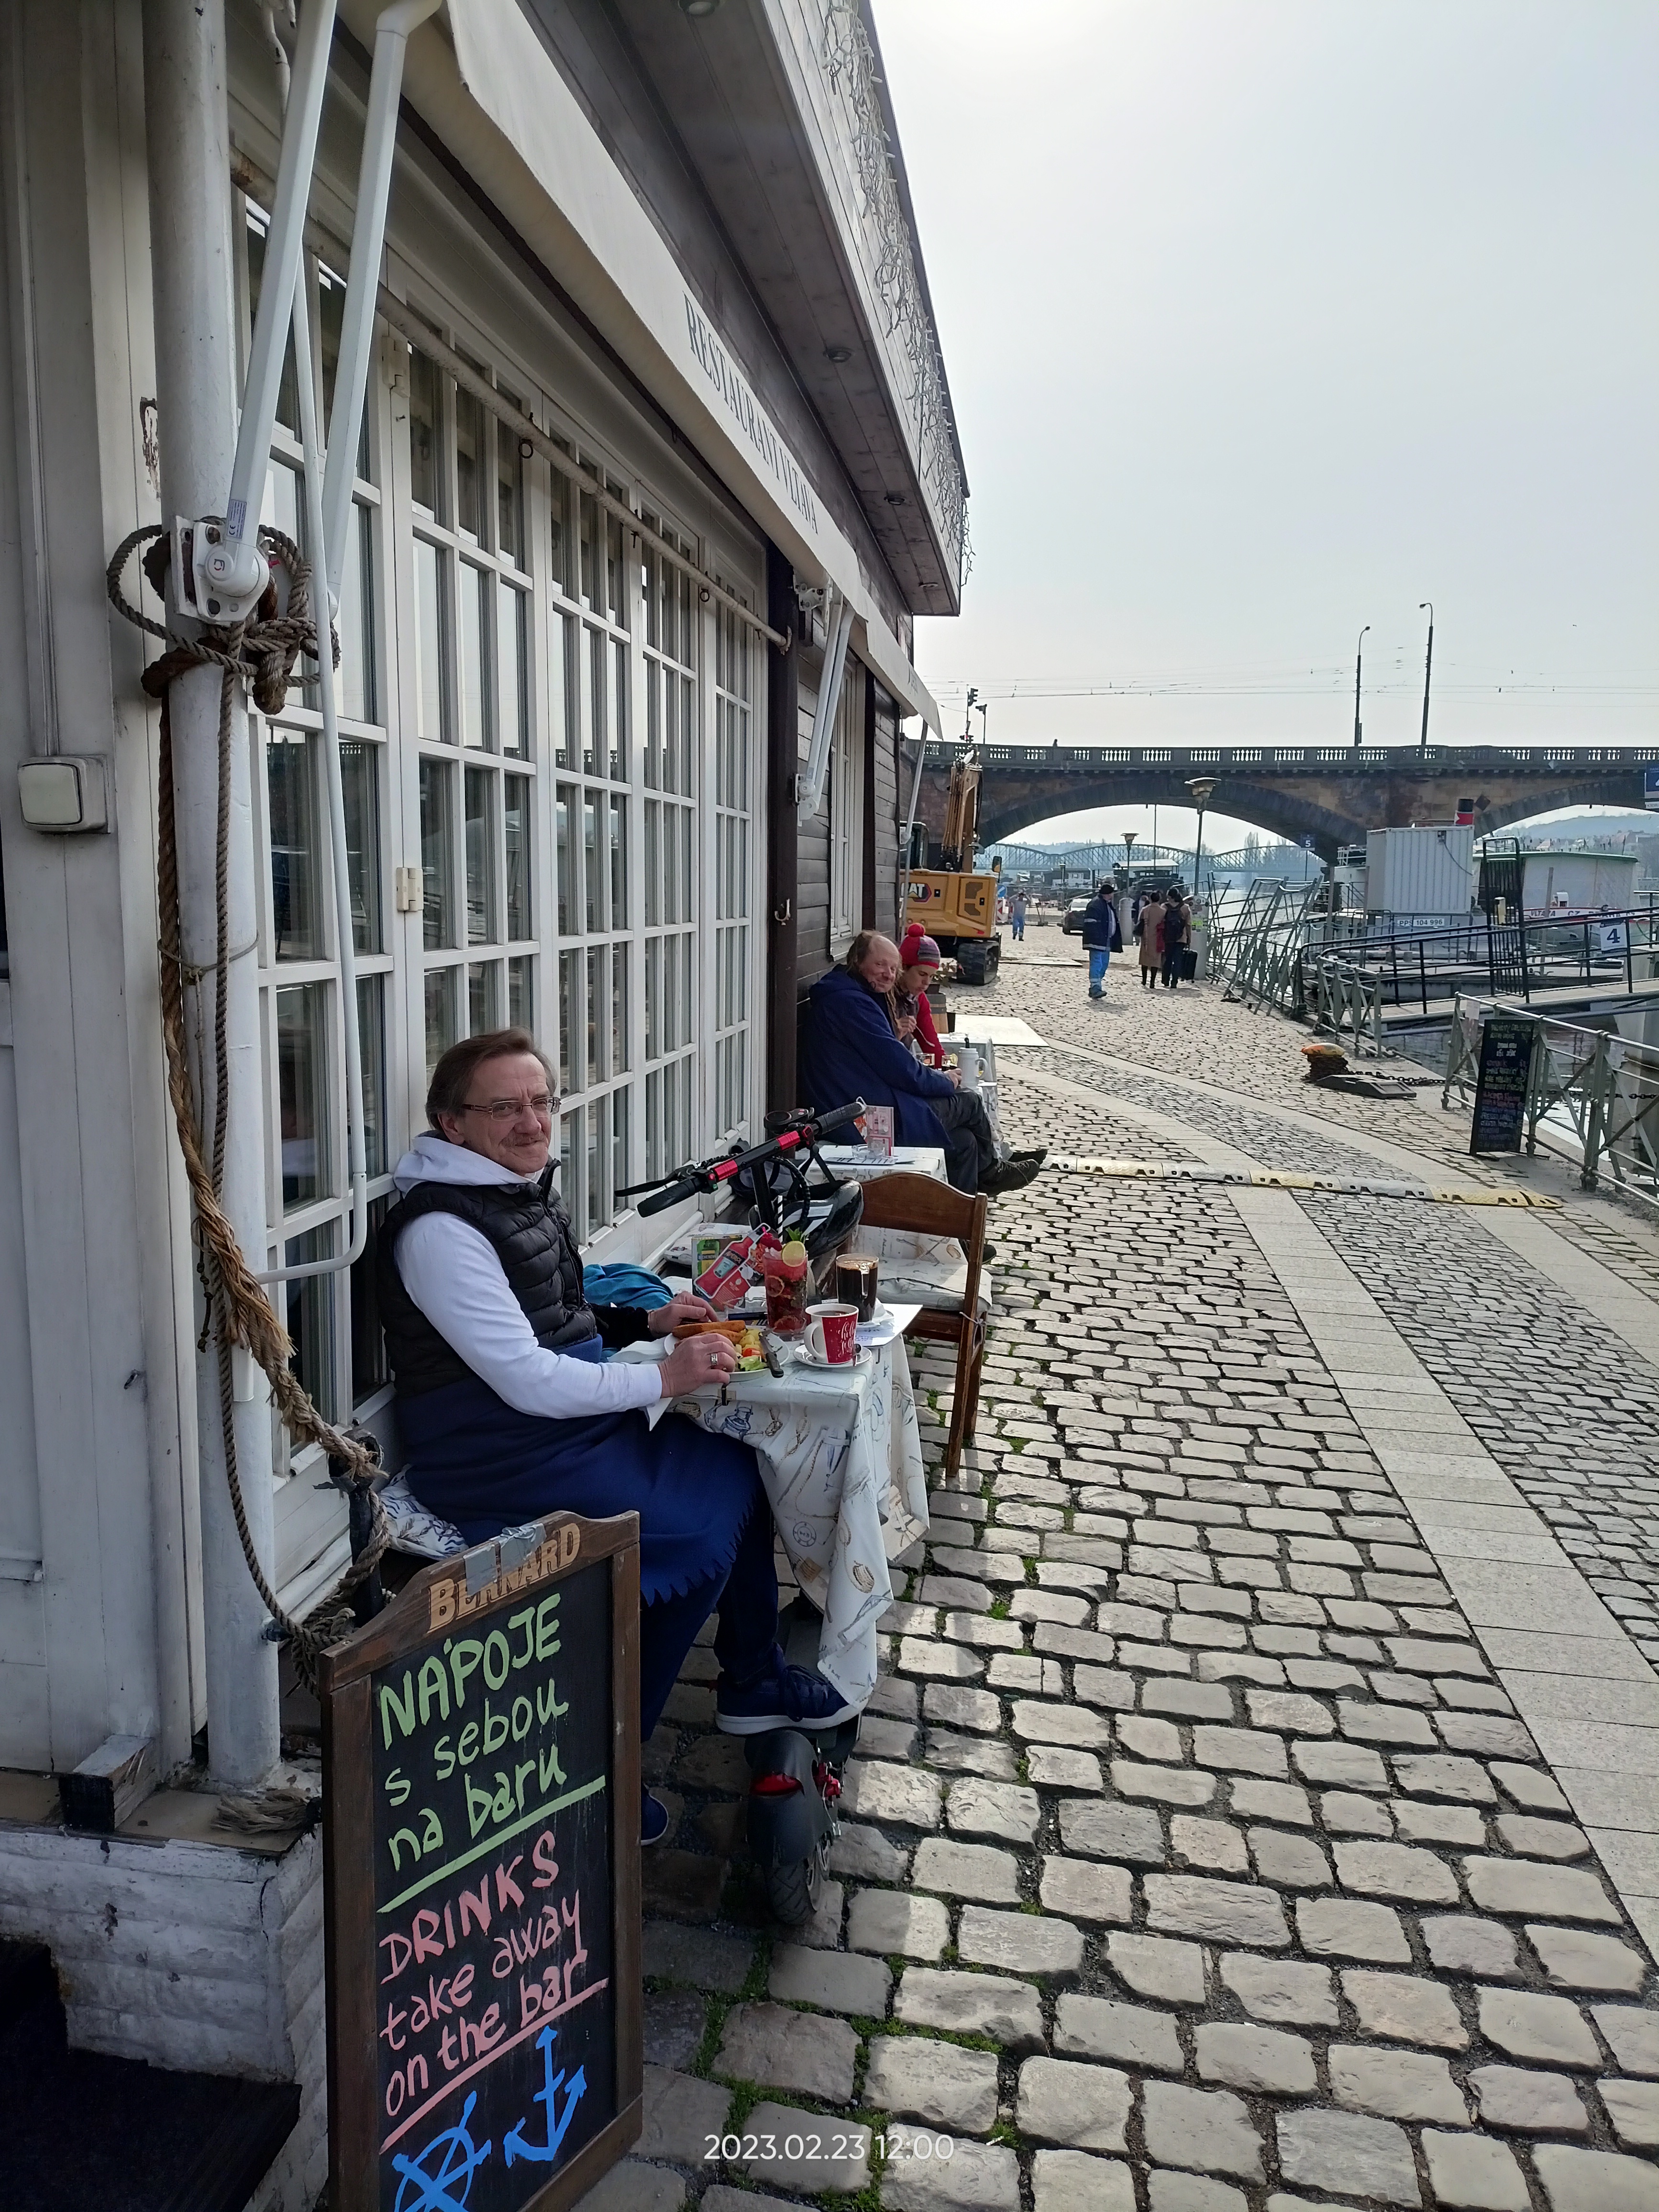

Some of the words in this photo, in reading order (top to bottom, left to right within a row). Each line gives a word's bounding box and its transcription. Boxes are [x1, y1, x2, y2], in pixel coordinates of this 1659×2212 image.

[682, 290, 780, 481] RESTAURANT
[778, 446, 818, 535] VLTAVA
[1606, 928, 1621, 944] 4
[380, 1593, 561, 1751] NÁPOJE
[434, 1678, 569, 1781] sebou
[388, 1808, 444, 1871] na
[464, 1744, 567, 1839] baru
[379, 1830, 559, 1985] DRINKS
[379, 1964, 475, 2050] take
[492, 1889, 580, 1978] away
[386, 2054, 429, 2116] on
[437, 2002, 507, 2070] the
[520, 1949, 588, 2028] bar
